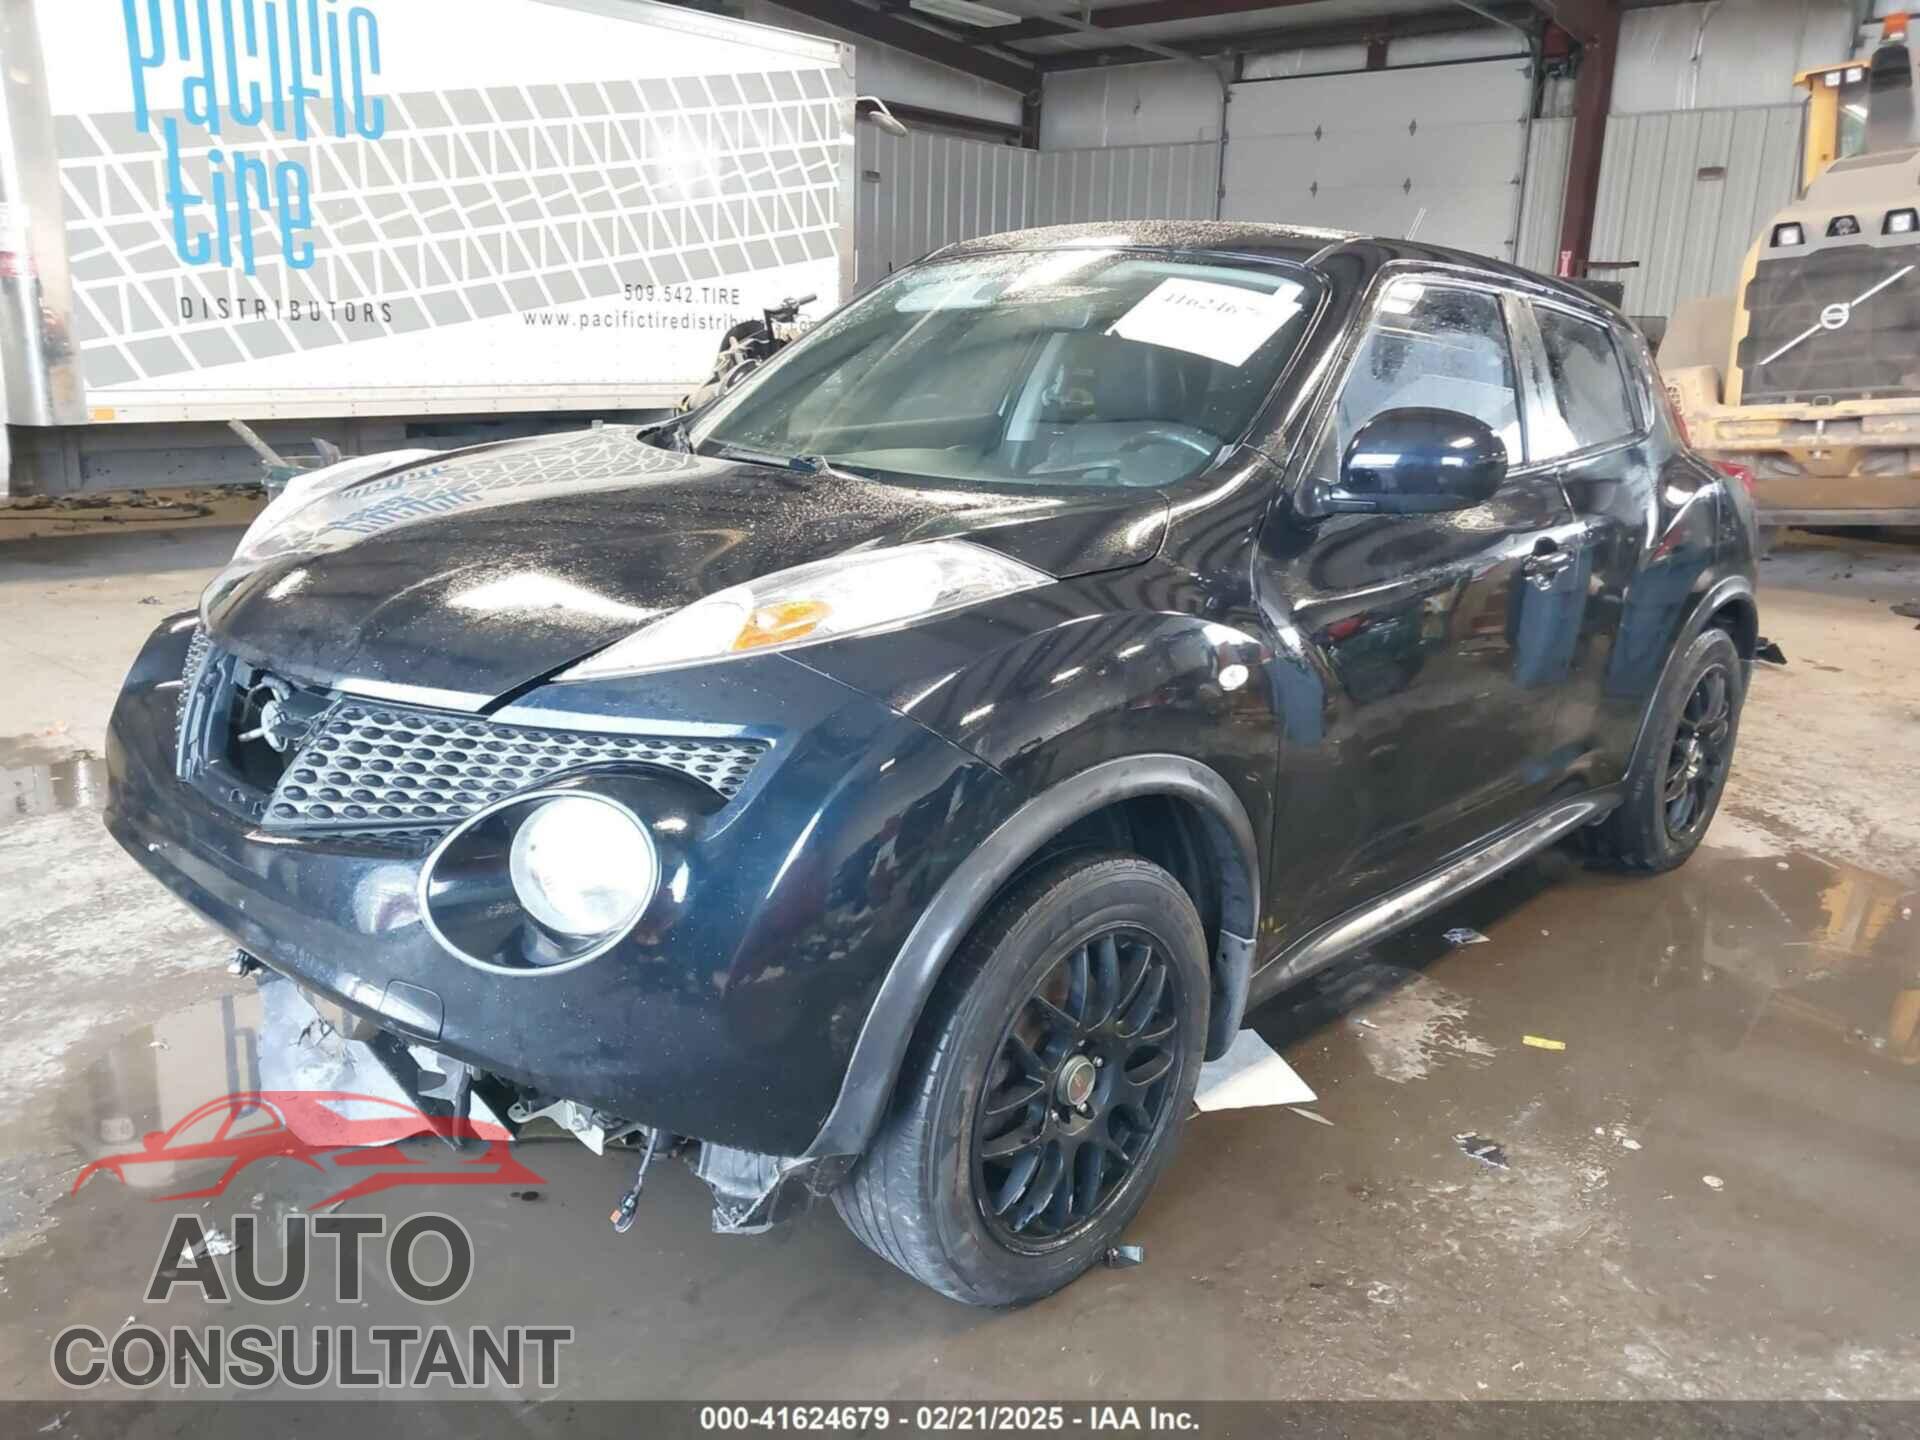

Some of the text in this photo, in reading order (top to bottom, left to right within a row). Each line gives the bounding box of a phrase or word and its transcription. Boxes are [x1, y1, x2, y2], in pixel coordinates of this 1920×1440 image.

[163, 117, 315, 276] tire
[623, 283, 741, 306] 509.542.TIRE
[181, 296, 393, 323] DISTRIBUTORS
